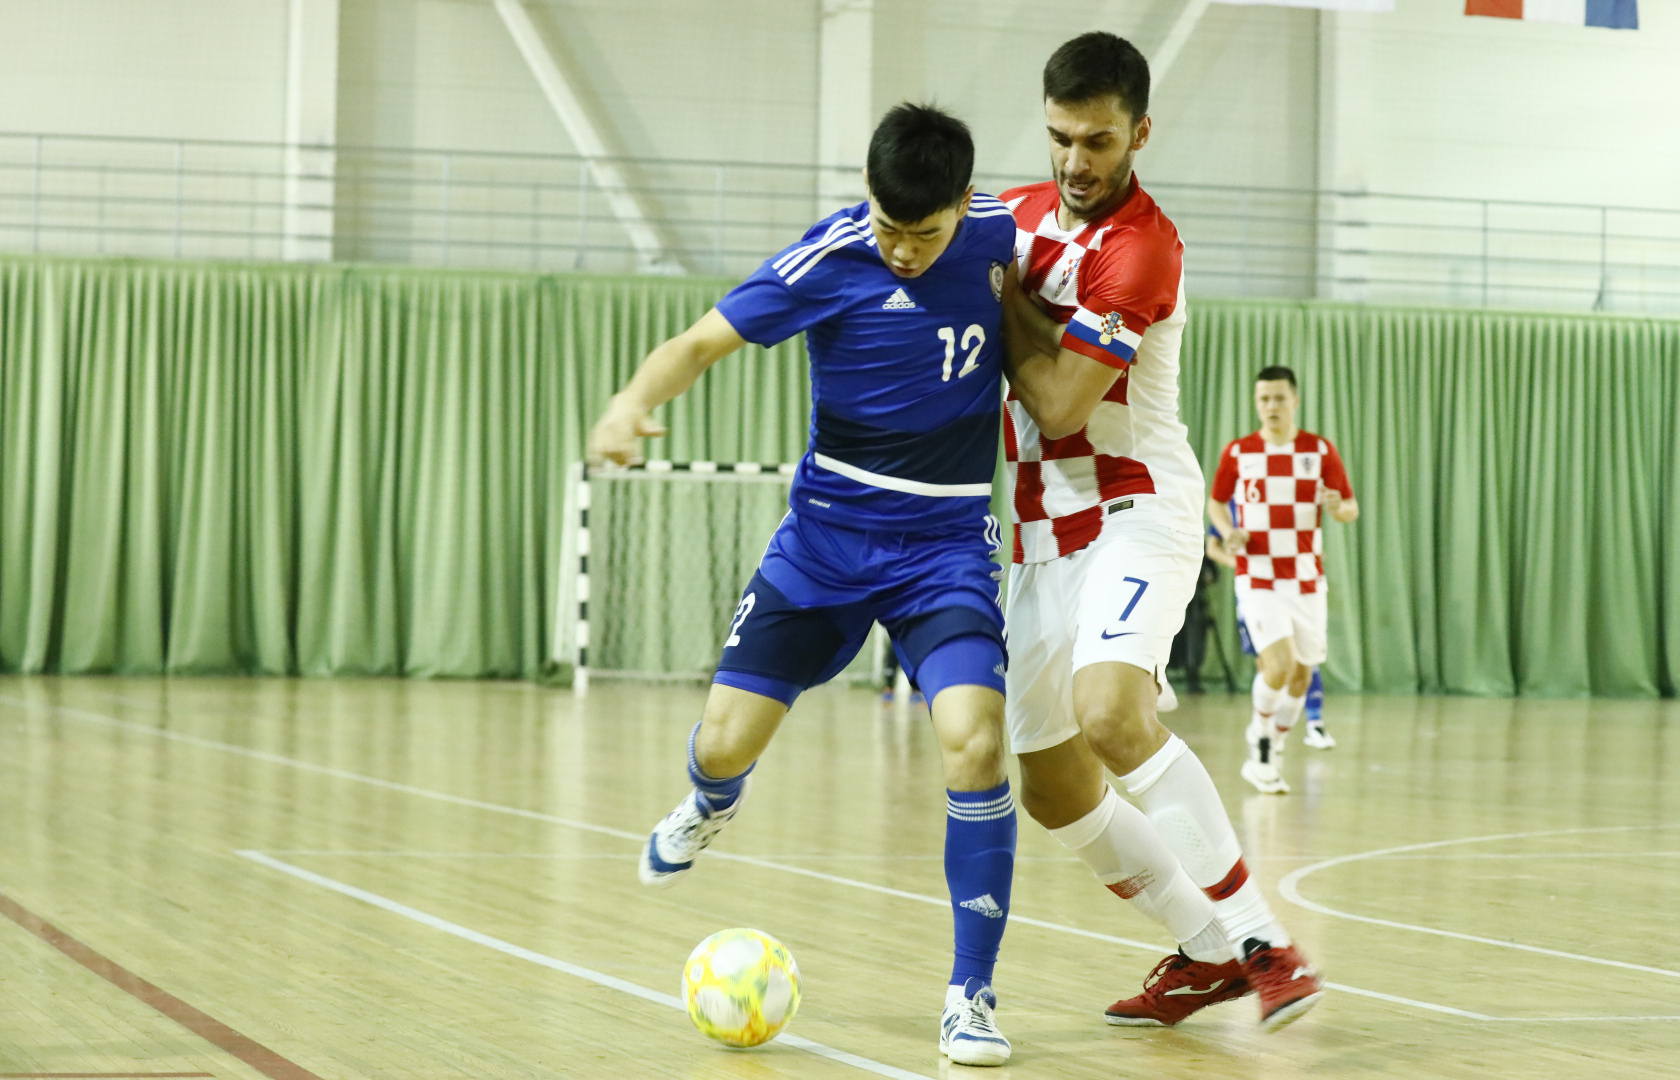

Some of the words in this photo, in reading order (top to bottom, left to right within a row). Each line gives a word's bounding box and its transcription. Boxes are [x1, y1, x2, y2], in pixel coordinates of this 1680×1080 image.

[937, 324, 986, 382] 12
[1246, 478, 1261, 503] 6
[723, 592, 756, 648] 2
[1119, 576, 1149, 621] 7
